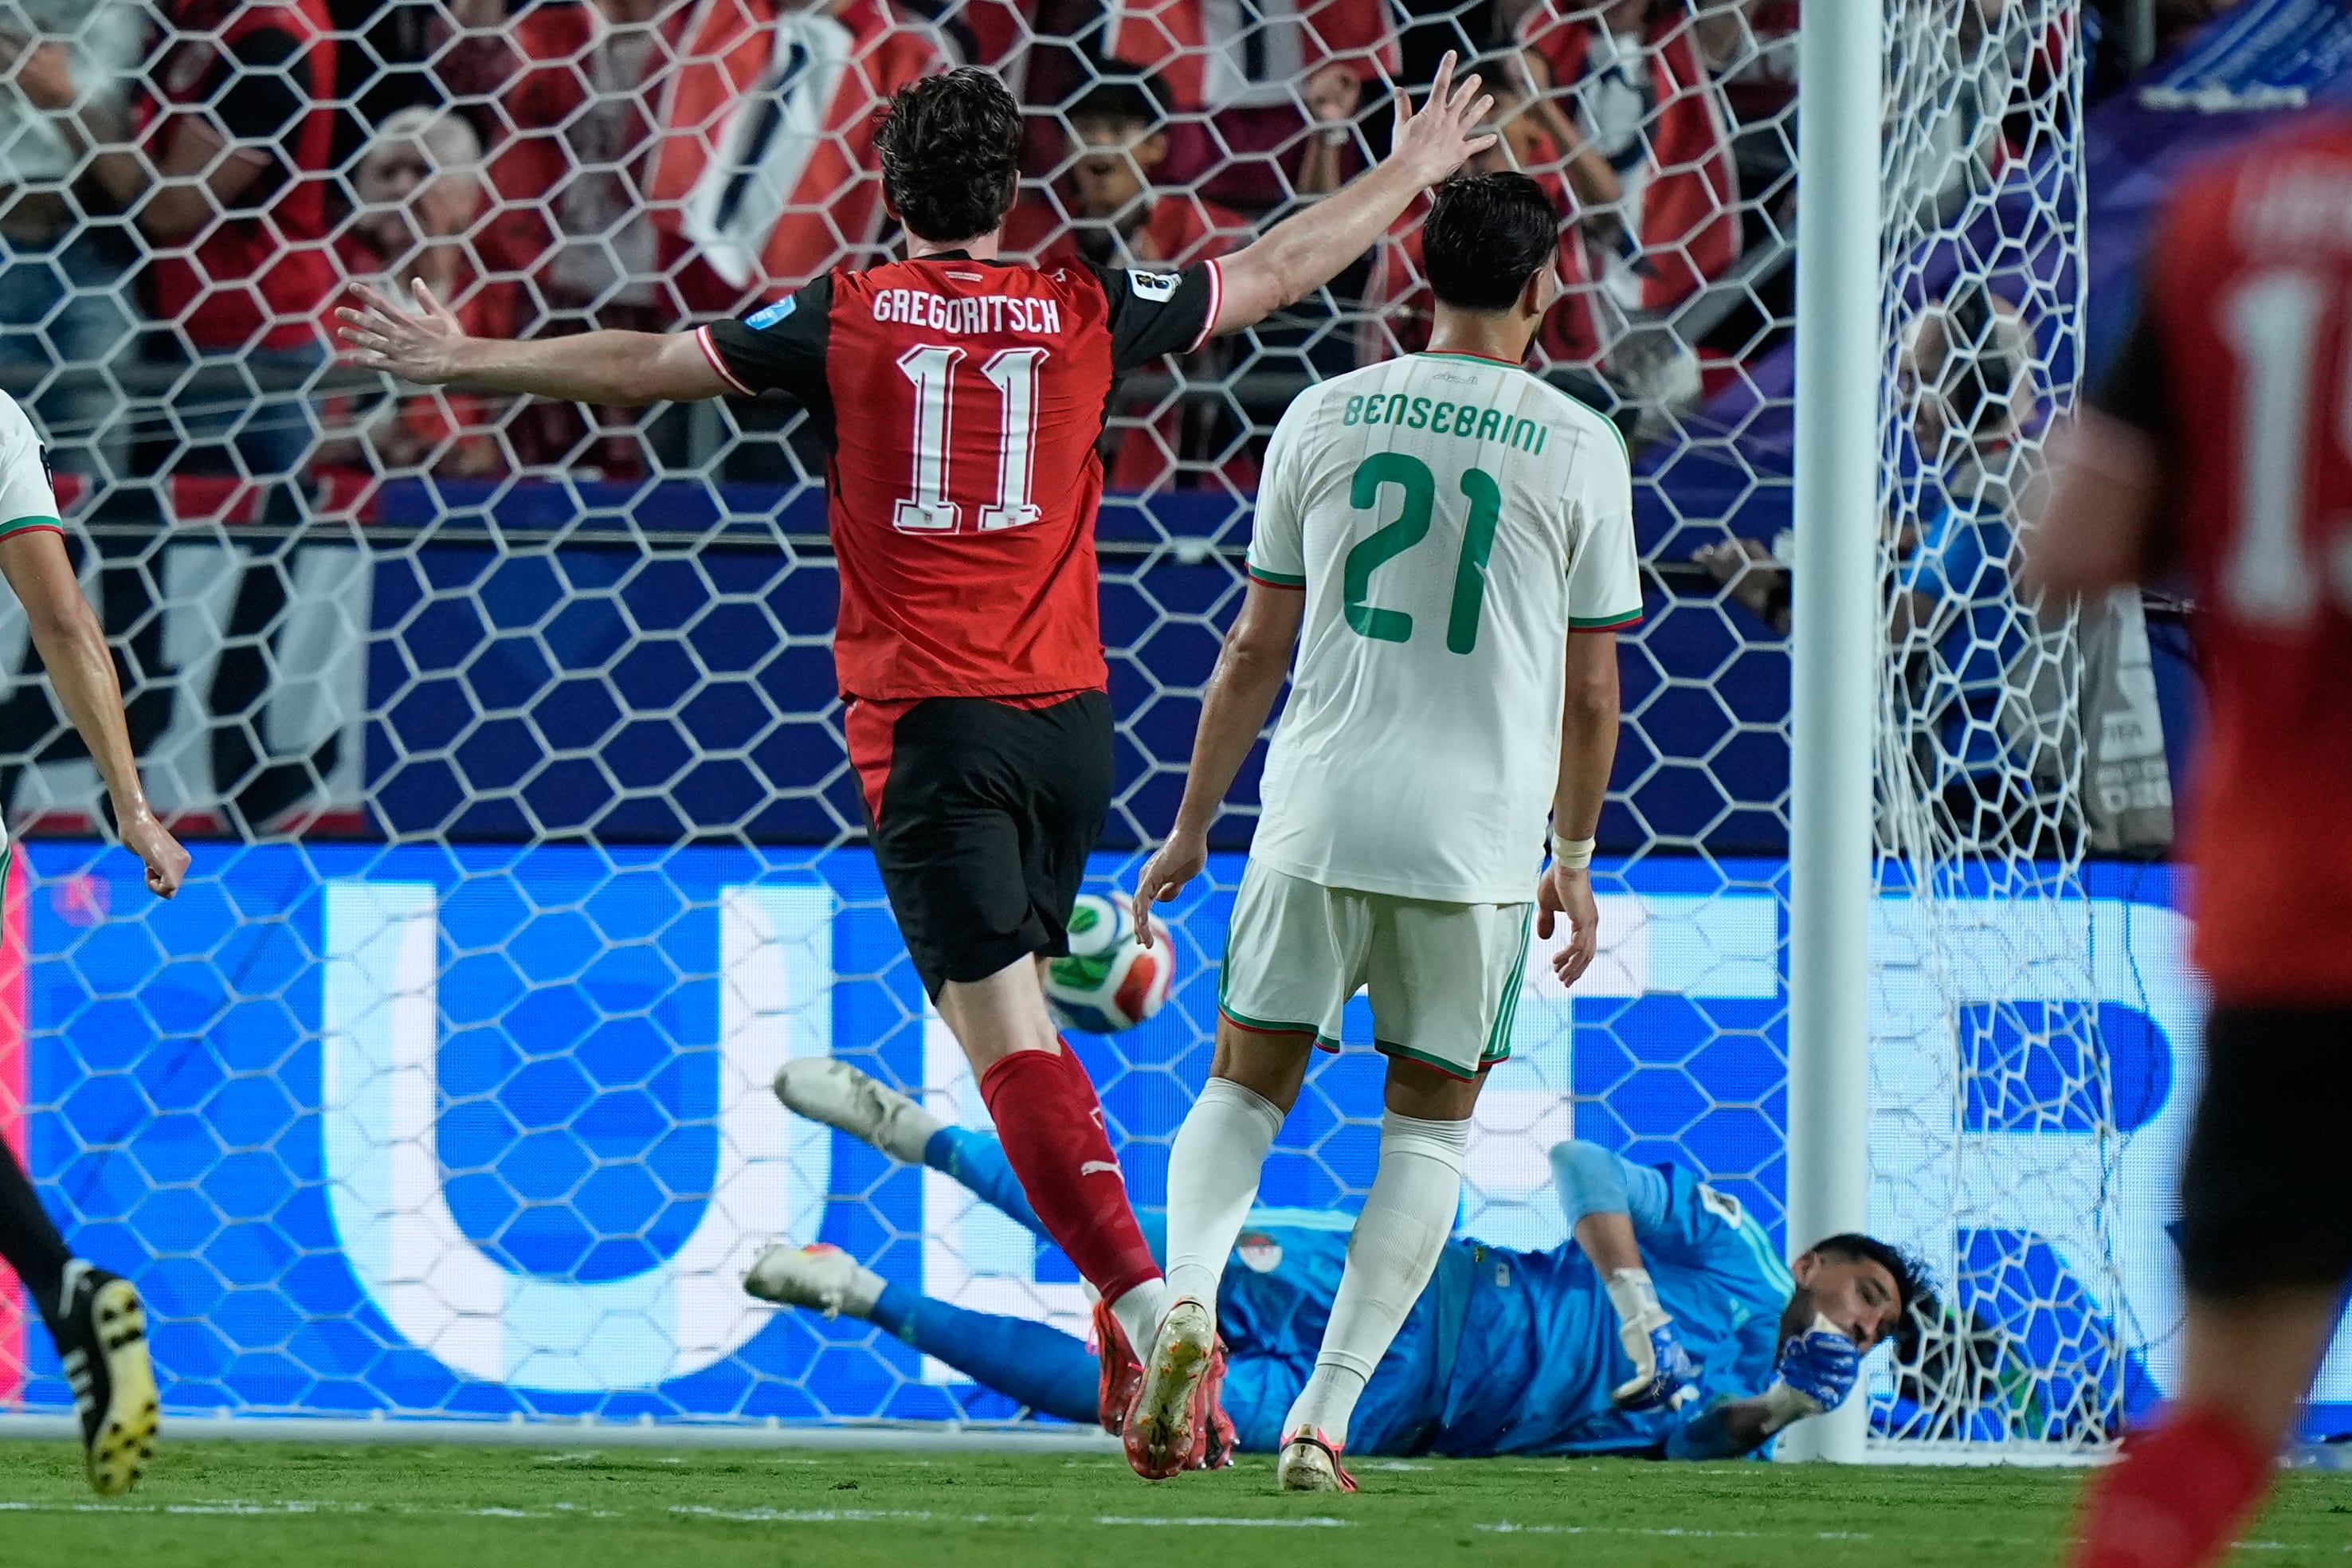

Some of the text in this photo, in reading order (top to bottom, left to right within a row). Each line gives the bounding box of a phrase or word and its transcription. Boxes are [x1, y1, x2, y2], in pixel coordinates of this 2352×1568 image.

[873, 288, 1060, 334] GREGORITSCH
[892, 343, 1051, 535] 11
[1343, 394, 1547, 456] BENSEBAINI
[2220, 269, 2352, 628] 1
[1343, 451, 1501, 655] 21
